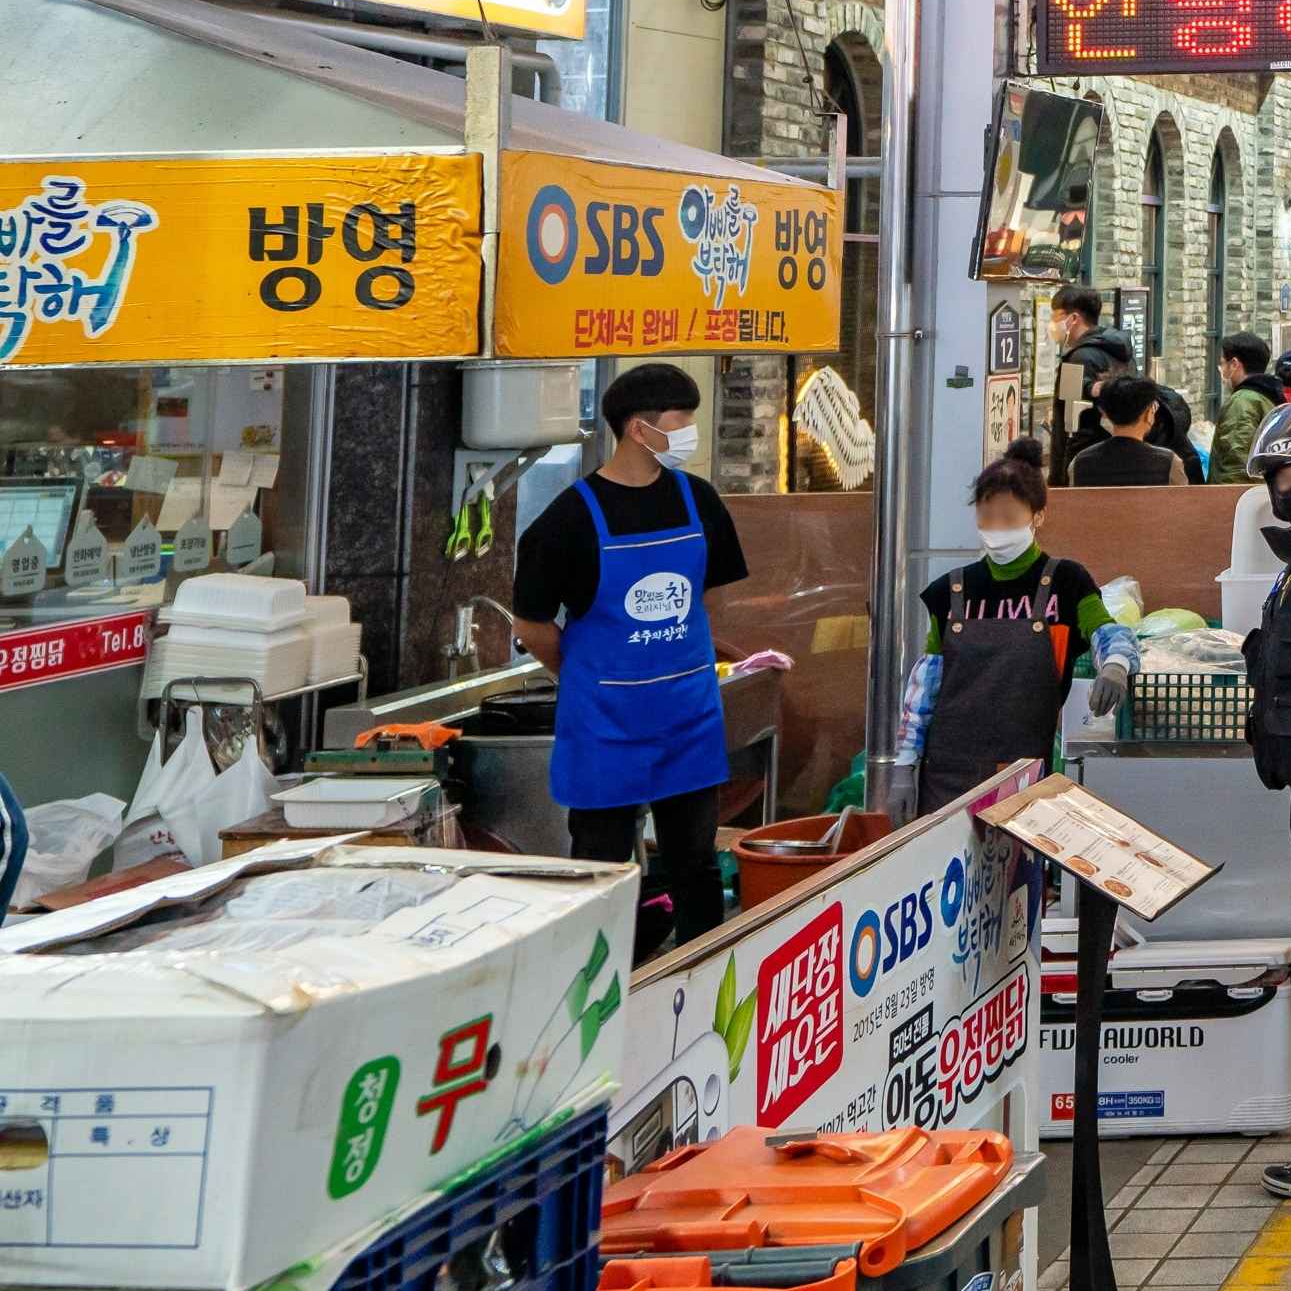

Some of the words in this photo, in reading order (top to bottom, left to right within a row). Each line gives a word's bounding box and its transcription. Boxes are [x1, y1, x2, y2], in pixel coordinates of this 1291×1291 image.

[248, 202, 417, 312] 방영
[584, 201, 665, 277] SBS
[775, 209, 828, 290] 방영
[574, 309, 634, 348] 단체석
[642, 309, 679, 346] 완비
[705, 308, 790, 344] 포장됩니다.
[1000, 337, 1014, 364] 12
[665, 581, 688, 609] 참
[883, 879, 934, 975] SBS
[852, 1007, 884, 1044] 2015년
[919, 964, 936, 996] 방영
[415, 1013, 495, 1155] 무
[1103, 1053, 1139, 1065] cooler
[342, 1065, 392, 1186] 청정
[0, 1188, 43, 1209] 산자
